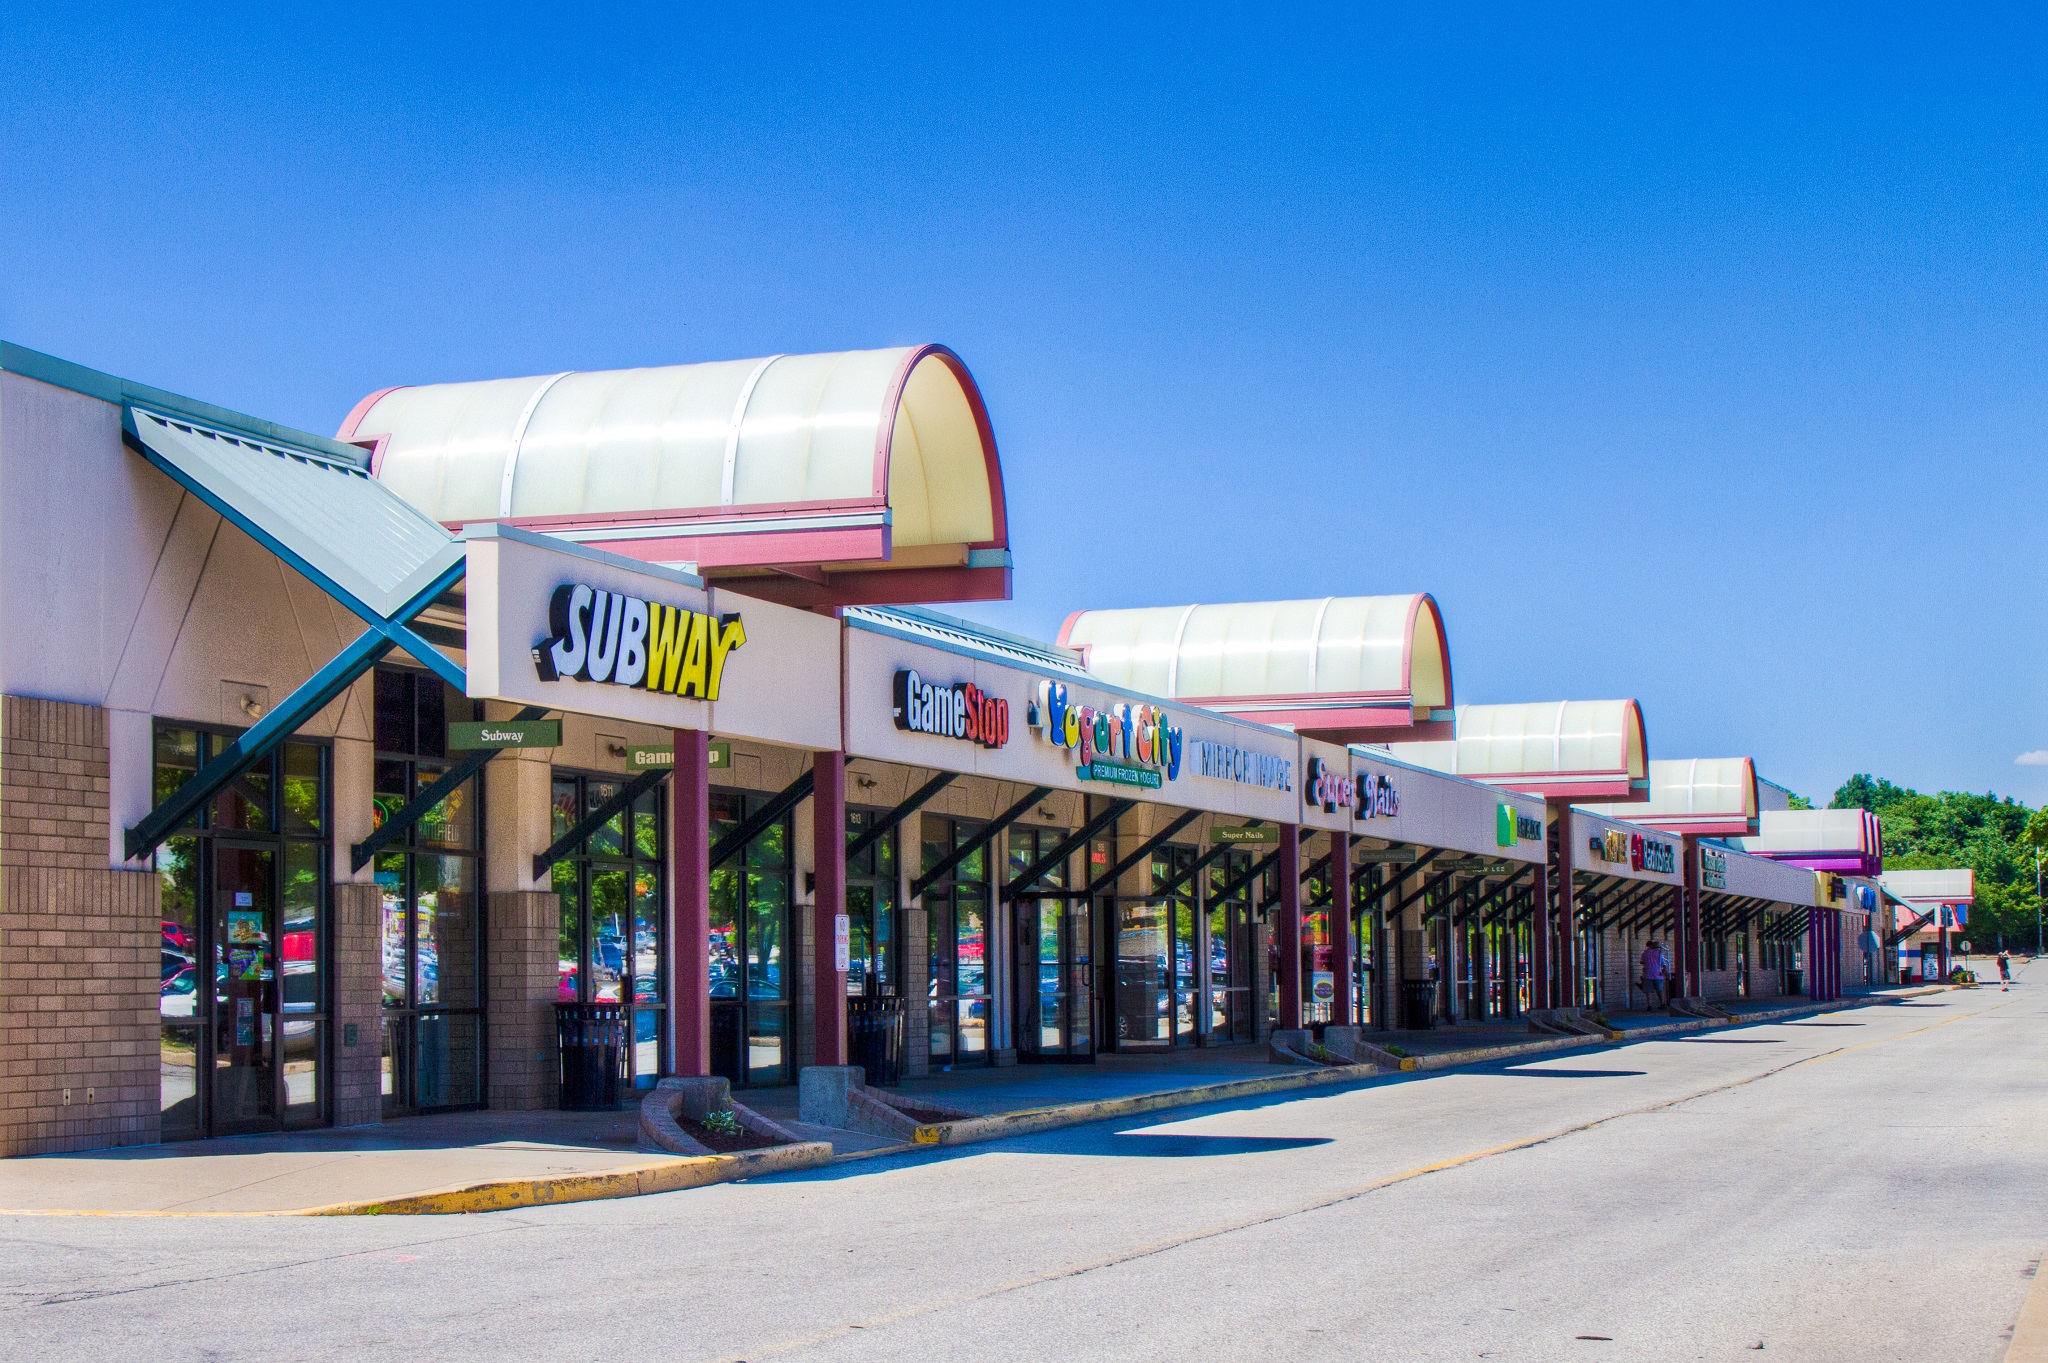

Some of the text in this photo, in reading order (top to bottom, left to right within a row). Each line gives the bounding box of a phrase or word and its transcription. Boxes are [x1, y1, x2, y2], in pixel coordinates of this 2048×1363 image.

[546, 582, 747, 701] SUBWAY
[480, 729, 524, 742] Subway
[903, 669, 1010, 749] GameStop
[1046, 680, 1183, 781] Yogurt City
[634, 750, 720, 765] Gamp
[1093, 764, 1160, 785] PREMIUM FROZEN YOGURT
[1199, 740, 1292, 793] MIRROR IMAGE
[1309, 757, 1400, 820] Super Nails
[1222, 831, 1264, 839] Super Nails
